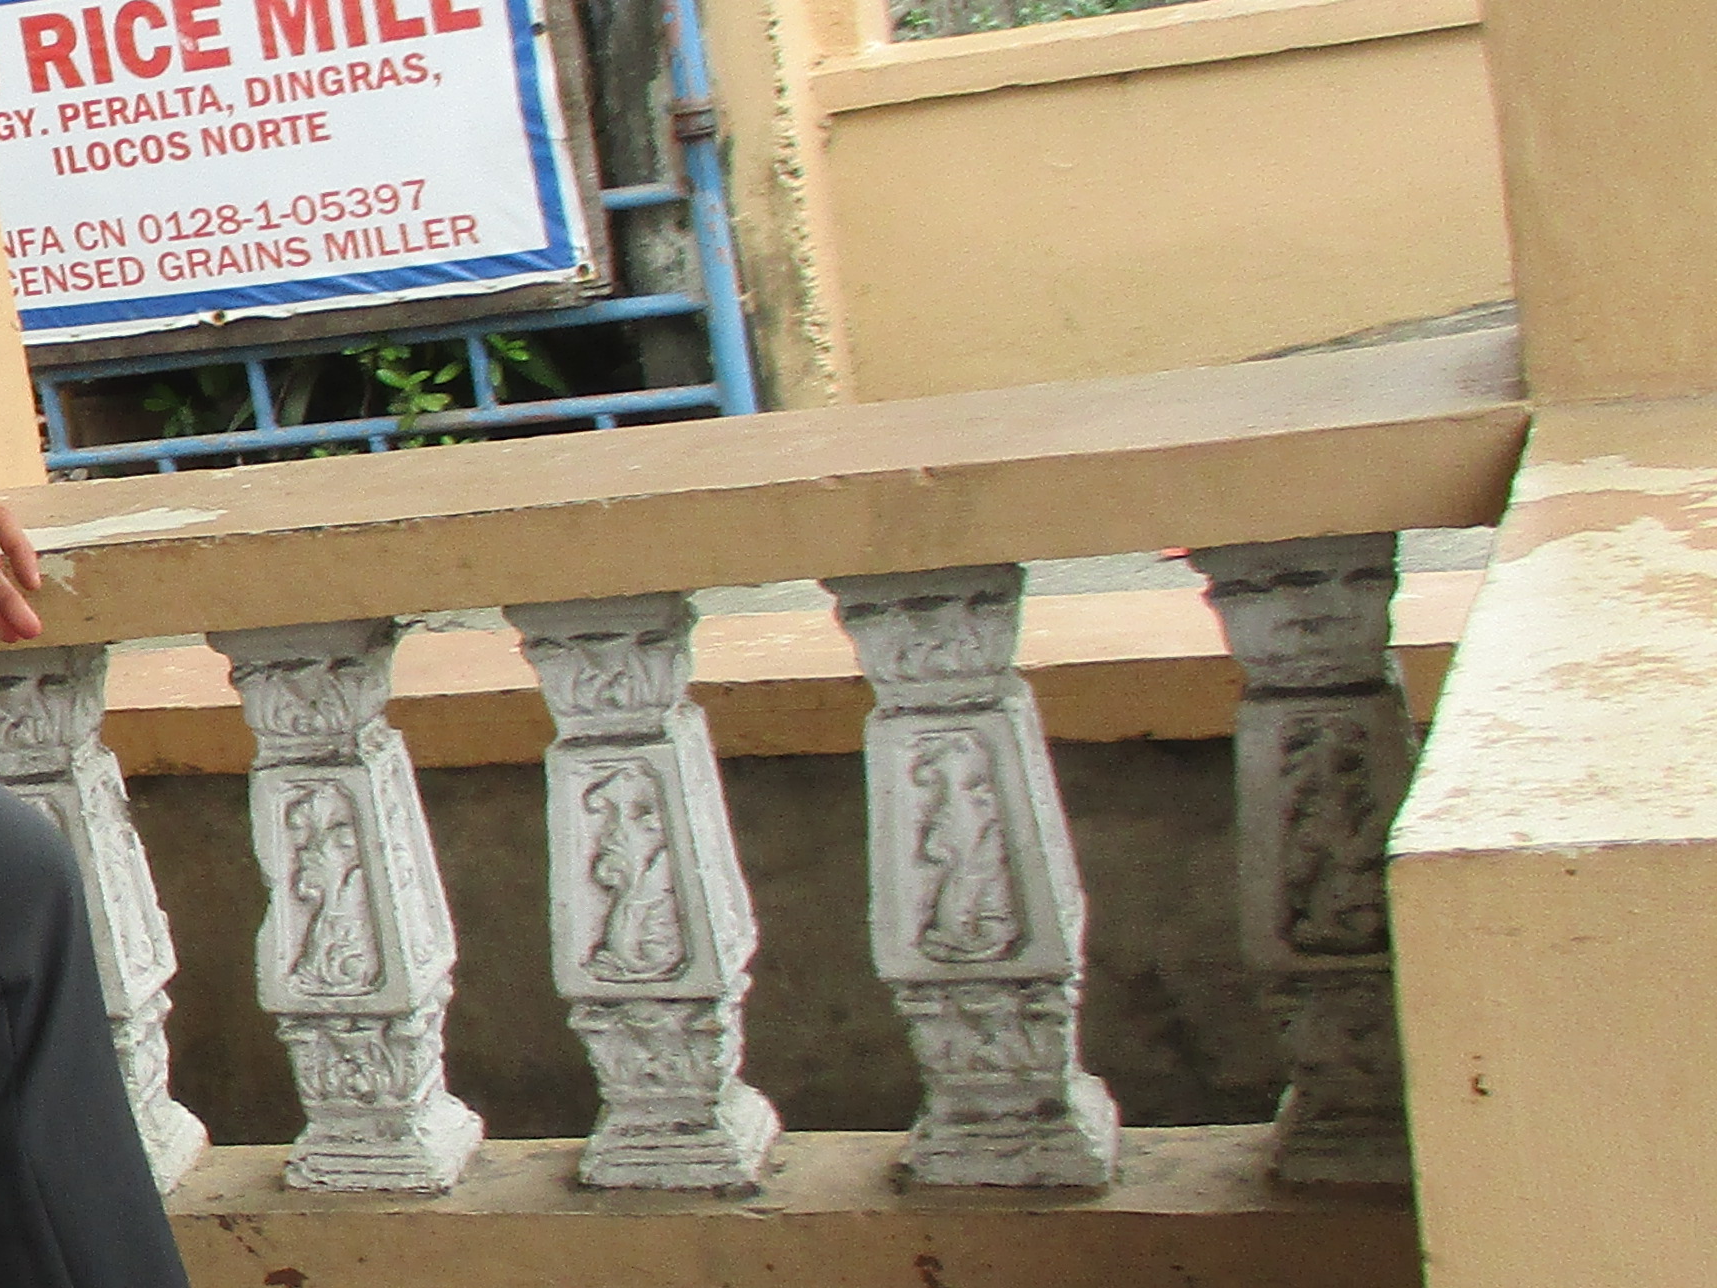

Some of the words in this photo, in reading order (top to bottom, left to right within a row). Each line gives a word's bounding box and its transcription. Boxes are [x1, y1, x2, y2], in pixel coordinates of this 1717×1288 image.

[57, 83, 236, 134] PERALTA,
[244, 52, 443, 109] DINGRAS,
[51, 130, 193, 176] ILOCOS
[200, 111, 333, 159] NORTE
[73, 217, 127, 252] CN
[136, 178, 427, 246] 0128-1-05397
[157, 236, 313, 284] GRAINS
[323, 214, 481, 263] MILLER
